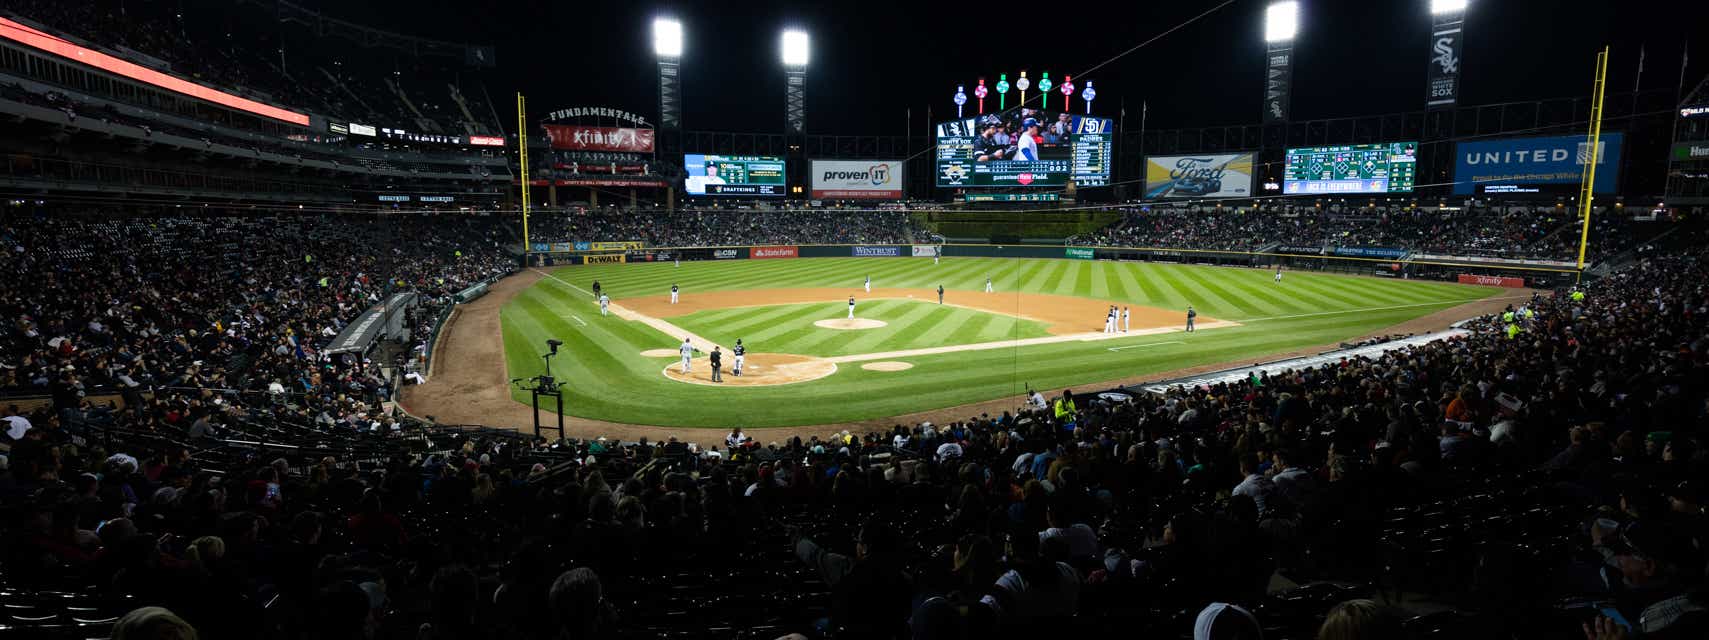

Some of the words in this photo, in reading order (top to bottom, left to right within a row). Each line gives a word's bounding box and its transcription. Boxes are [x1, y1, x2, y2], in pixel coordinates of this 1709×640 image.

[1431, 88, 1453, 97] SOX
[550, 107, 645, 125] FUNDAMENTALS
[1467, 149, 1569, 164] UNITED
[1170, 158, 1226, 180] Ford
[824, 171, 868, 182] proven
[874, 170, 885, 179] IT
[856, 246, 896, 255] WINTRUST
[1478, 277, 1502, 286] xfinity
